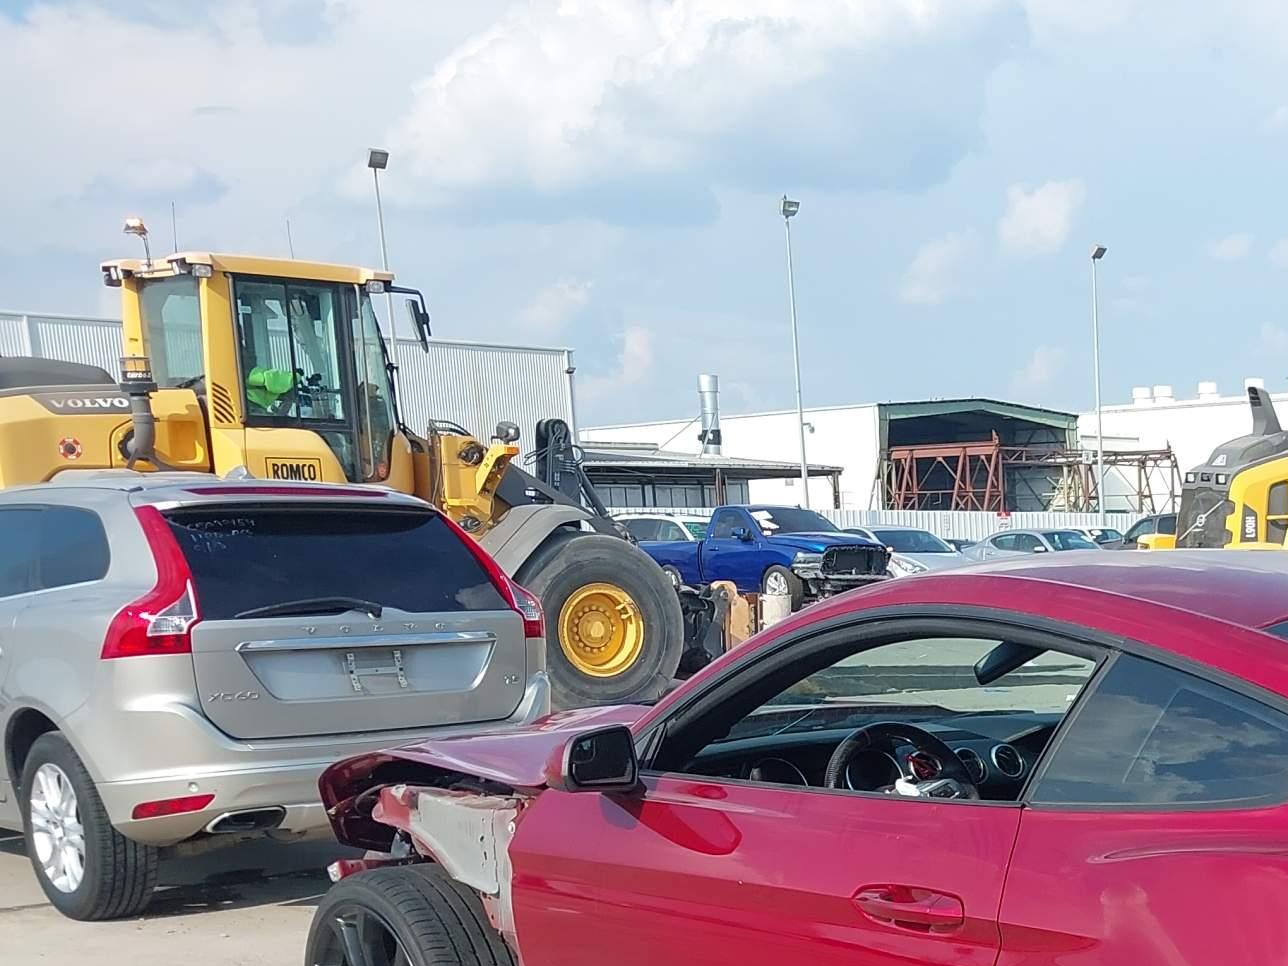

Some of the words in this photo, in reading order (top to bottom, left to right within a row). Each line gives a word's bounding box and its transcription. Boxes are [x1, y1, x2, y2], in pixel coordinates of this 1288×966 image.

[50, 397, 129, 408] VOLVO
[272, 463, 317, 481] ROMCO
[1245, 516, 1256, 538] L90H
